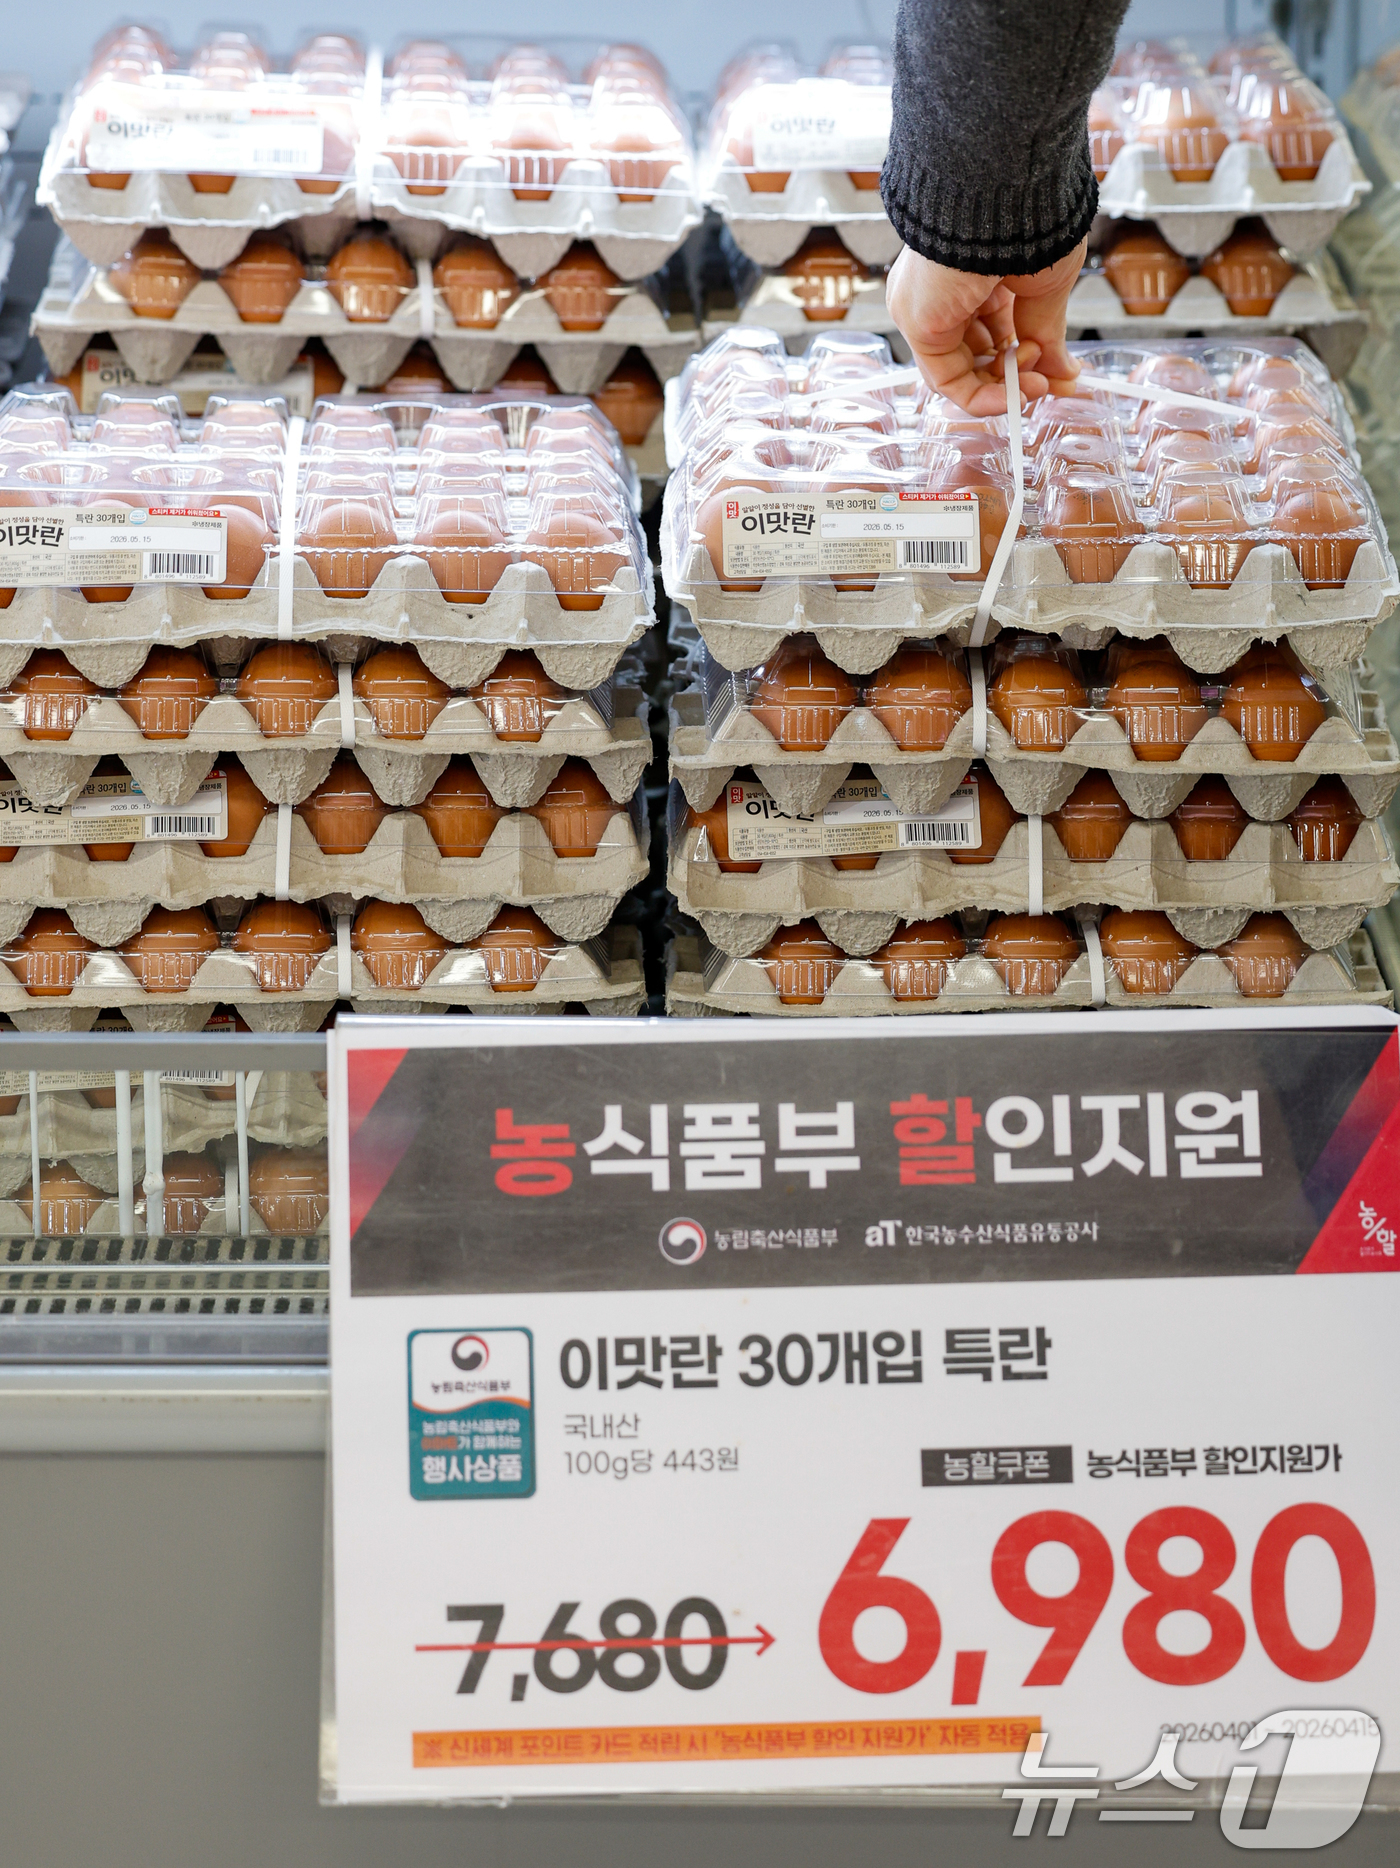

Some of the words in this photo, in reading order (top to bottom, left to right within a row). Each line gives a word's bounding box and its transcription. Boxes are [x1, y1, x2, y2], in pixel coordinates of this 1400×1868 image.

[76, 514, 93, 523] 특란
[96, 514, 125, 523] 30개입
[762, 502, 780, 510] 정성을
[796, 504, 815, 512] 선별한
[826, 500, 844, 510] 특란
[846, 499, 876, 510] 30개입
[741, 512, 816, 535] 이맛란
[98, 783, 126, 793] 30개입
[732, 788, 742, 803] 이맛
[848, 787, 877, 798] 30개입
[489, 1101, 861, 1196] 농식품부
[890, 1089, 1264, 1186] 할인지원
[714, 1227, 839, 1251] 농림축산식품부
[905, 1220, 1099, 1246] 한국농수산식품유통공사
[560, 1333, 723, 1391] 이맛란
[738, 1328, 923, 1388] 30개입
[943, 1326, 1052, 1382] 특란
[563, 1412, 641, 1440] 국내산
[422, 1454, 522, 1484] 행사상품
[564, 1450, 653, 1480] 100g당
[662, 1447, 739, 1474] 443원
[943, 1450, 1050, 1482] 농할쿠폰
[1086, 1446, 1197, 1479] 농식품부
[1203, 1444, 1342, 1476] 할인지원가
[818, 1501, 1377, 1706] 6,980
[446, 1596, 729, 1702] 7,680
[450, 1736, 514, 1761] 신세계
[520, 1734, 584, 1759] 포인트
[590, 1732, 632, 1757] 카드
[638, 1732, 680, 1756] 적립
[688, 1731, 708, 1755] 시
[812, 1727, 856, 1752] 할인
[938, 1724, 980, 1748] 자동
[987, 1722, 1030, 1746] 적용
